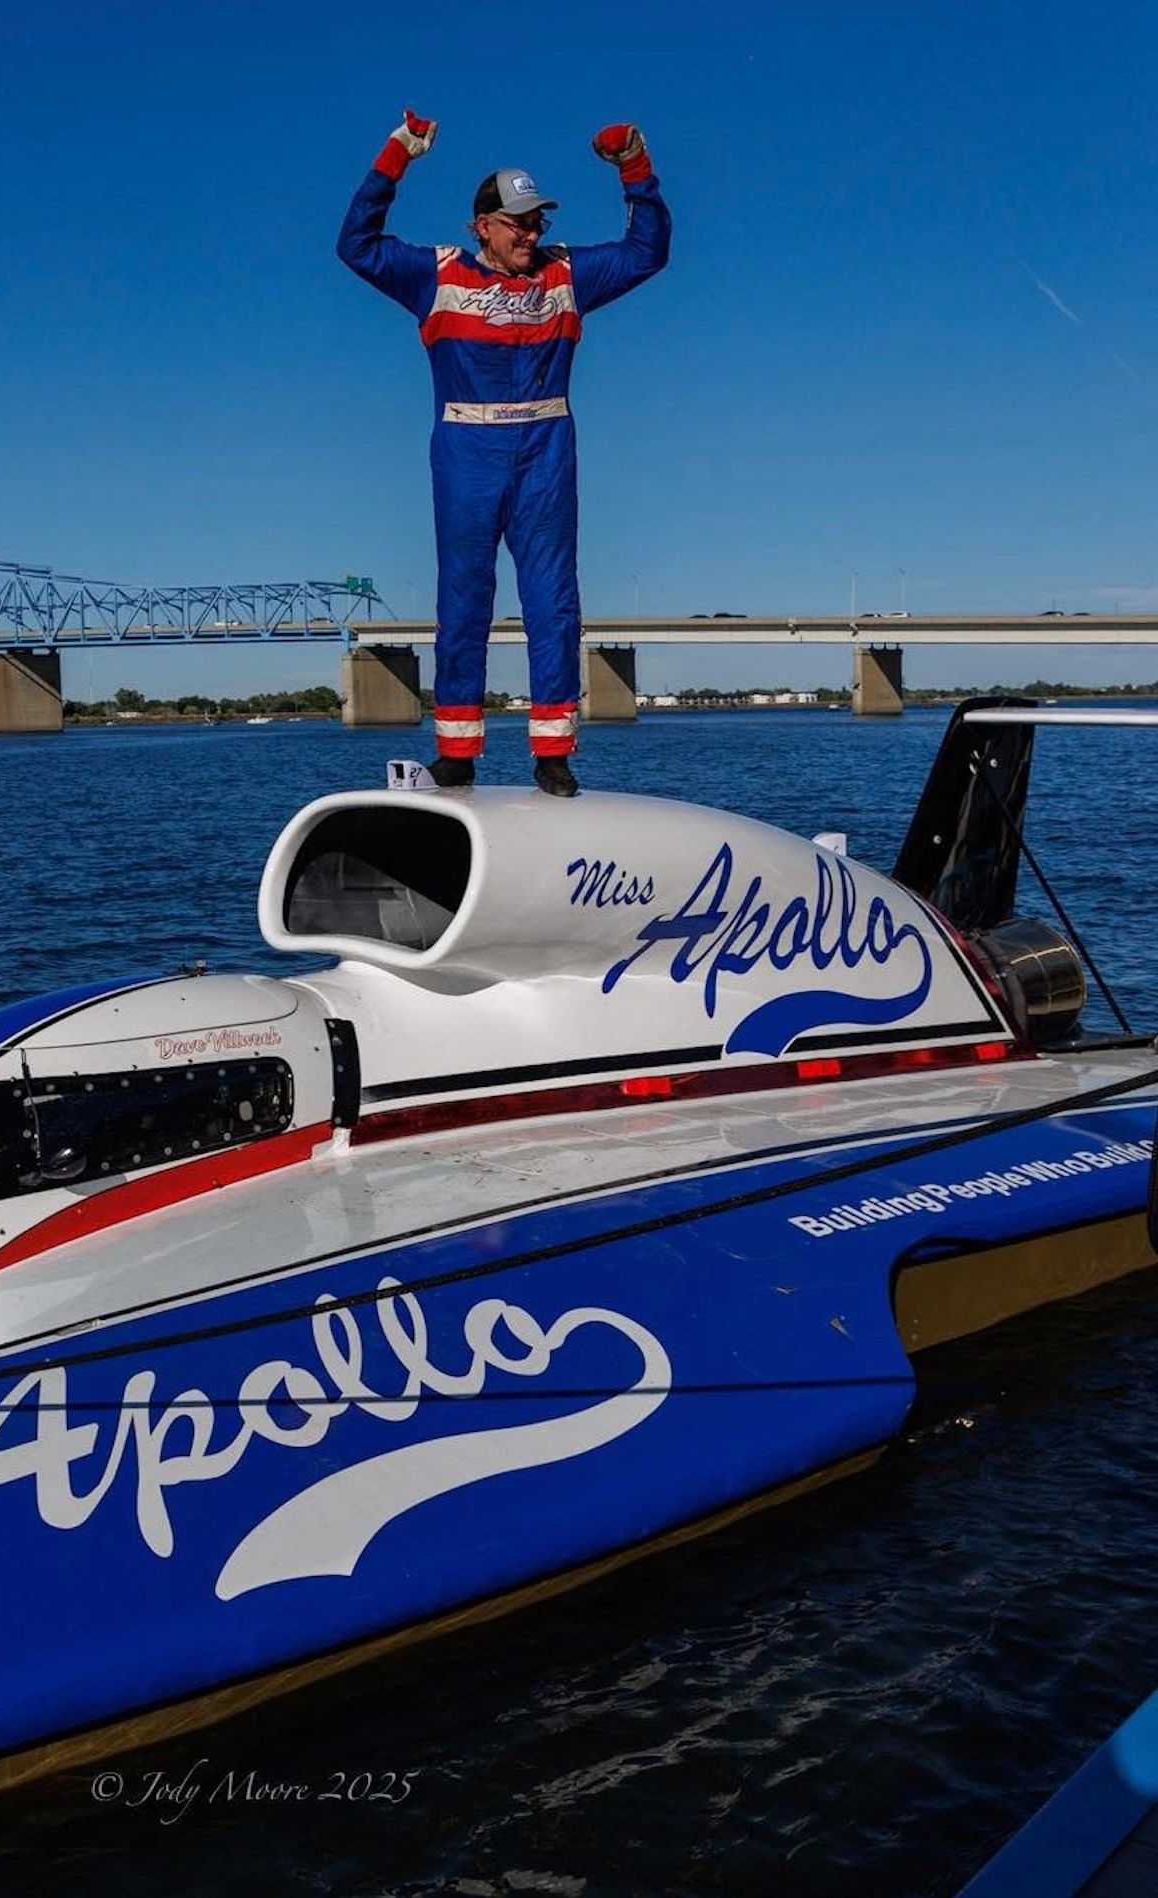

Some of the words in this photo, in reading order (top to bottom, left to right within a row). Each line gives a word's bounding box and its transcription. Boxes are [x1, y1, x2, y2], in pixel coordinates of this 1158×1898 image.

[566, 857, 656, 908] Miss
[601, 842, 932, 1058] Apollo
[154, 1037, 206, 1060] Dave
[787, 1192, 946, 1238] Building
[918, 1171, 1032, 1204] People
[1010, 1159, 1092, 1182] Who
